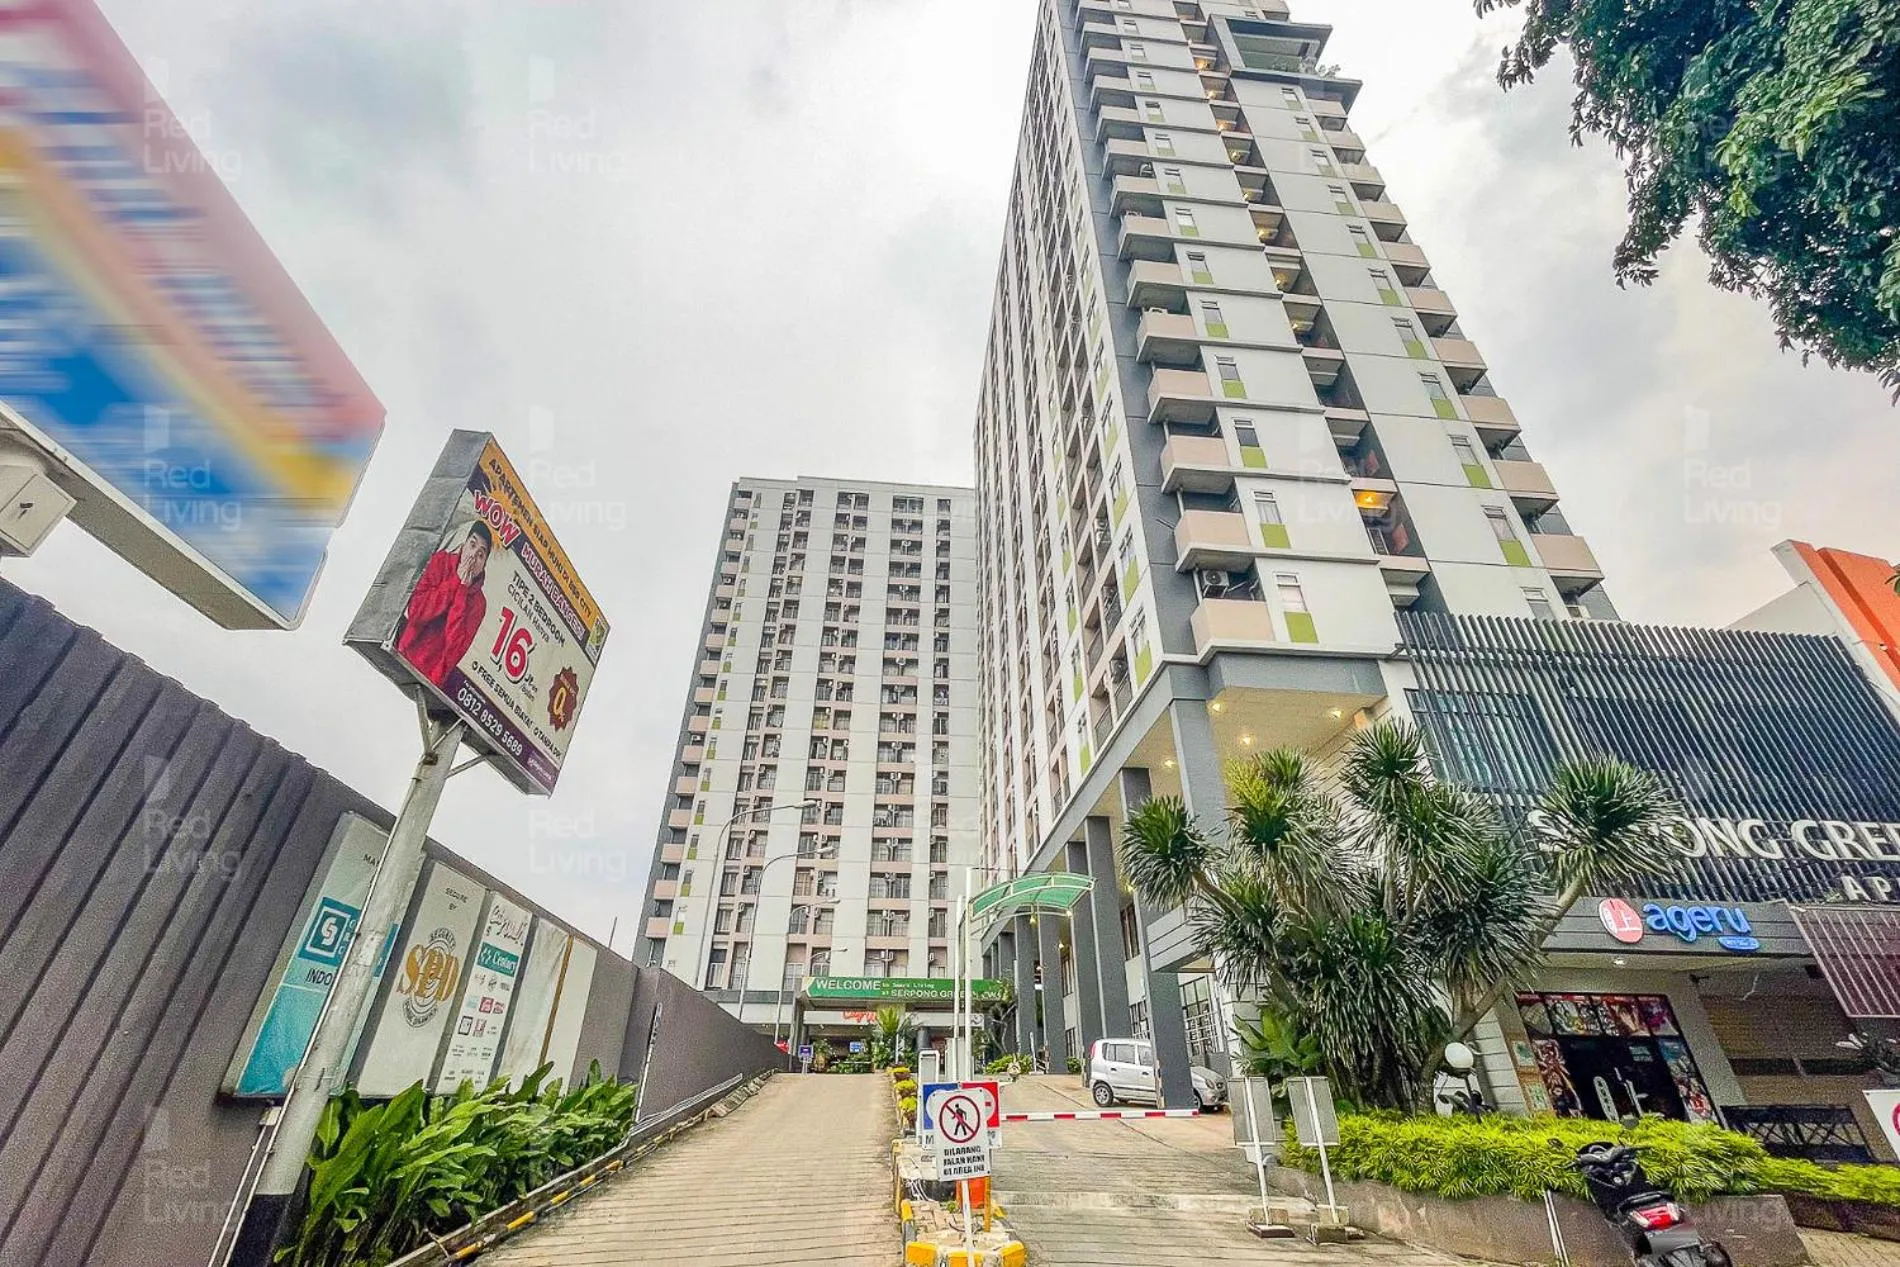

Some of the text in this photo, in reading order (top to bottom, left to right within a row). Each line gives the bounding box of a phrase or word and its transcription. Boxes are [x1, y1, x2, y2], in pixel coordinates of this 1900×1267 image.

[474, 490, 521, 547] WOW
[513, 570, 566, 647] TIPE 2 BEDROOM
[477, 666, 495, 688] FREE
[457, 687, 482, 717] 0812
[480, 709, 503, 736] 8529
[501, 732, 523, 756] 5689
[815, 979, 882, 990] WELCOME
[891, 989, 939, 998] SERPONG
